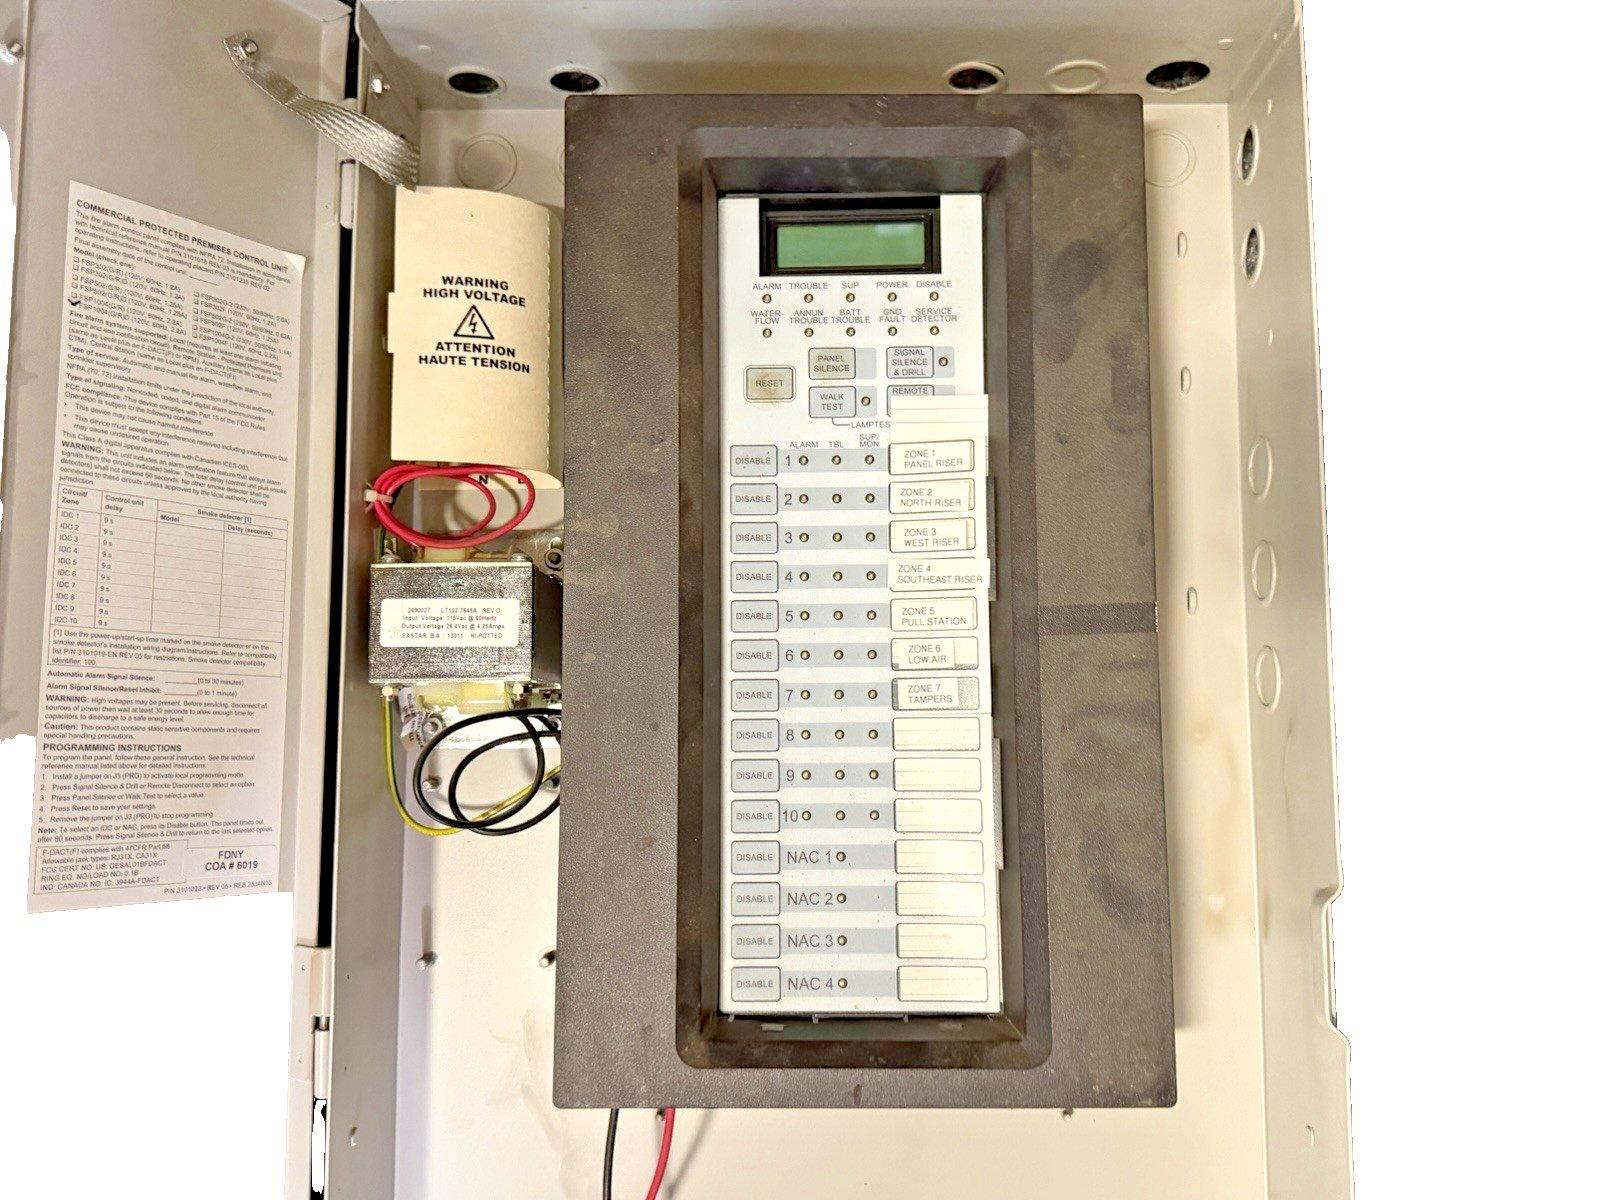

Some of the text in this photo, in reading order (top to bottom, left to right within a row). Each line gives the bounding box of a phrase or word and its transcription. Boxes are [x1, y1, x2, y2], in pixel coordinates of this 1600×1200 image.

[76, 199, 288, 273] COMMERCIAL PROTECTED PREMISES CONTROL UNIT
[442, 275, 509, 290] WARNING
[423, 288, 526, 307] HIGH VOLTAGE
[436, 341, 515, 357] ATTENTION
[419, 354, 530, 374] HAUTE TENSION
[785, 455, 791, 466] 1
[904, 460, 933, 468] PANEL
[479, 474, 488, 484] N
[61, 497, 79, 505] Zone
[105, 495, 130, 504] Control
[785, 493, 792, 505] 2
[105, 504, 123, 513] delay
[197, 509, 218, 517] Smoke
[227, 524, 273, 537] Delay (seconds)
[785, 532, 792, 544] 3
[933, 537, 959, 546] RISER
[785, 571, 793, 582] 4
[786, 610, 793, 621] 5
[927, 617, 967, 625] STATION
[786, 650, 793, 661] 6
[46, 695, 90, 703] WARNING:
[786, 690, 793, 701] 7
[908, 695, 952, 703] TAMPERS
[44, 722, 78, 730] Caution:
[786, 729, 794, 741] 8
[43, 743, 115, 752] PROGRAMMING
[786, 770, 794, 781] 9
[782, 810, 798, 822] 10
[218, 850, 244, 859] FDNY
[788, 851, 831, 863] NAC 1
[205, 861, 226, 871] COA
[237, 860, 258, 869] 6019
[788, 893, 833, 905] NAC 2
[788, 934, 833, 947] NAC 3
[788, 978, 833, 990] NAC 4
